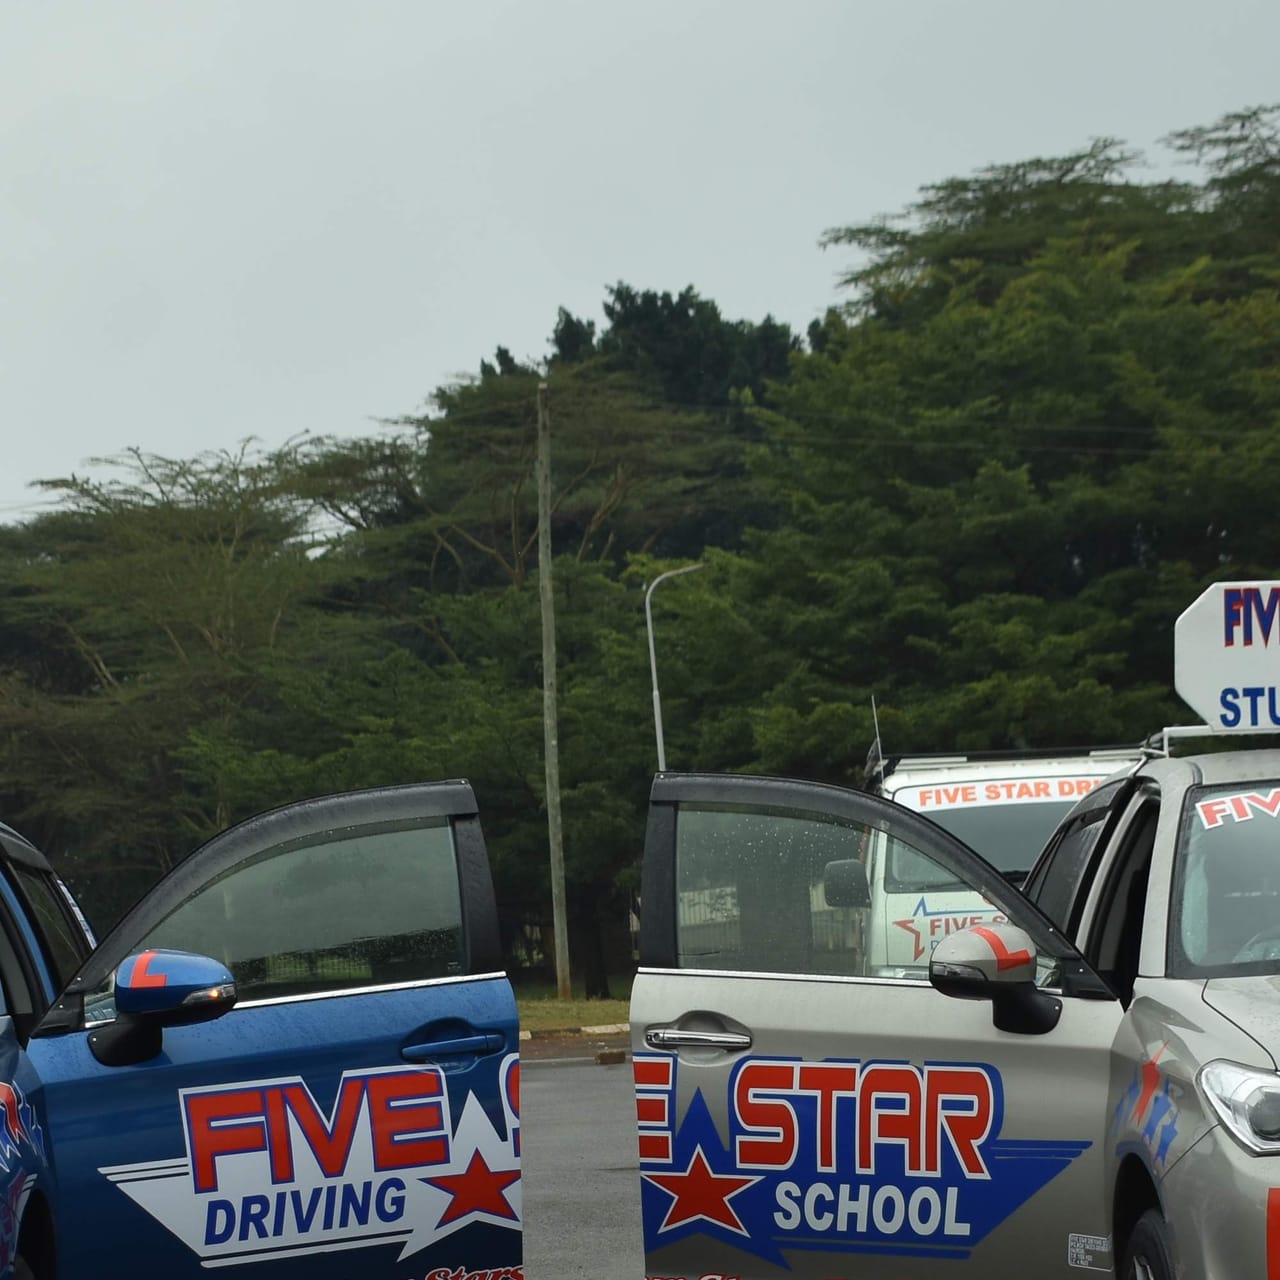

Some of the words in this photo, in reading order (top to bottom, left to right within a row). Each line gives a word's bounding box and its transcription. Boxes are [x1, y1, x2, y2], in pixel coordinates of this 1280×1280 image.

[919, 785, 977, 806] FIVE
[985, 781, 1051, 801] STAR
[130, 950, 167, 988] L
[971, 927, 1031, 970] L
[184, 1068, 452, 1194] FIVE
[734, 1060, 992, 1181] STAR
[204, 1177, 407, 1246] DRIVING
[773, 1180, 971, 1236] SCHOOL
